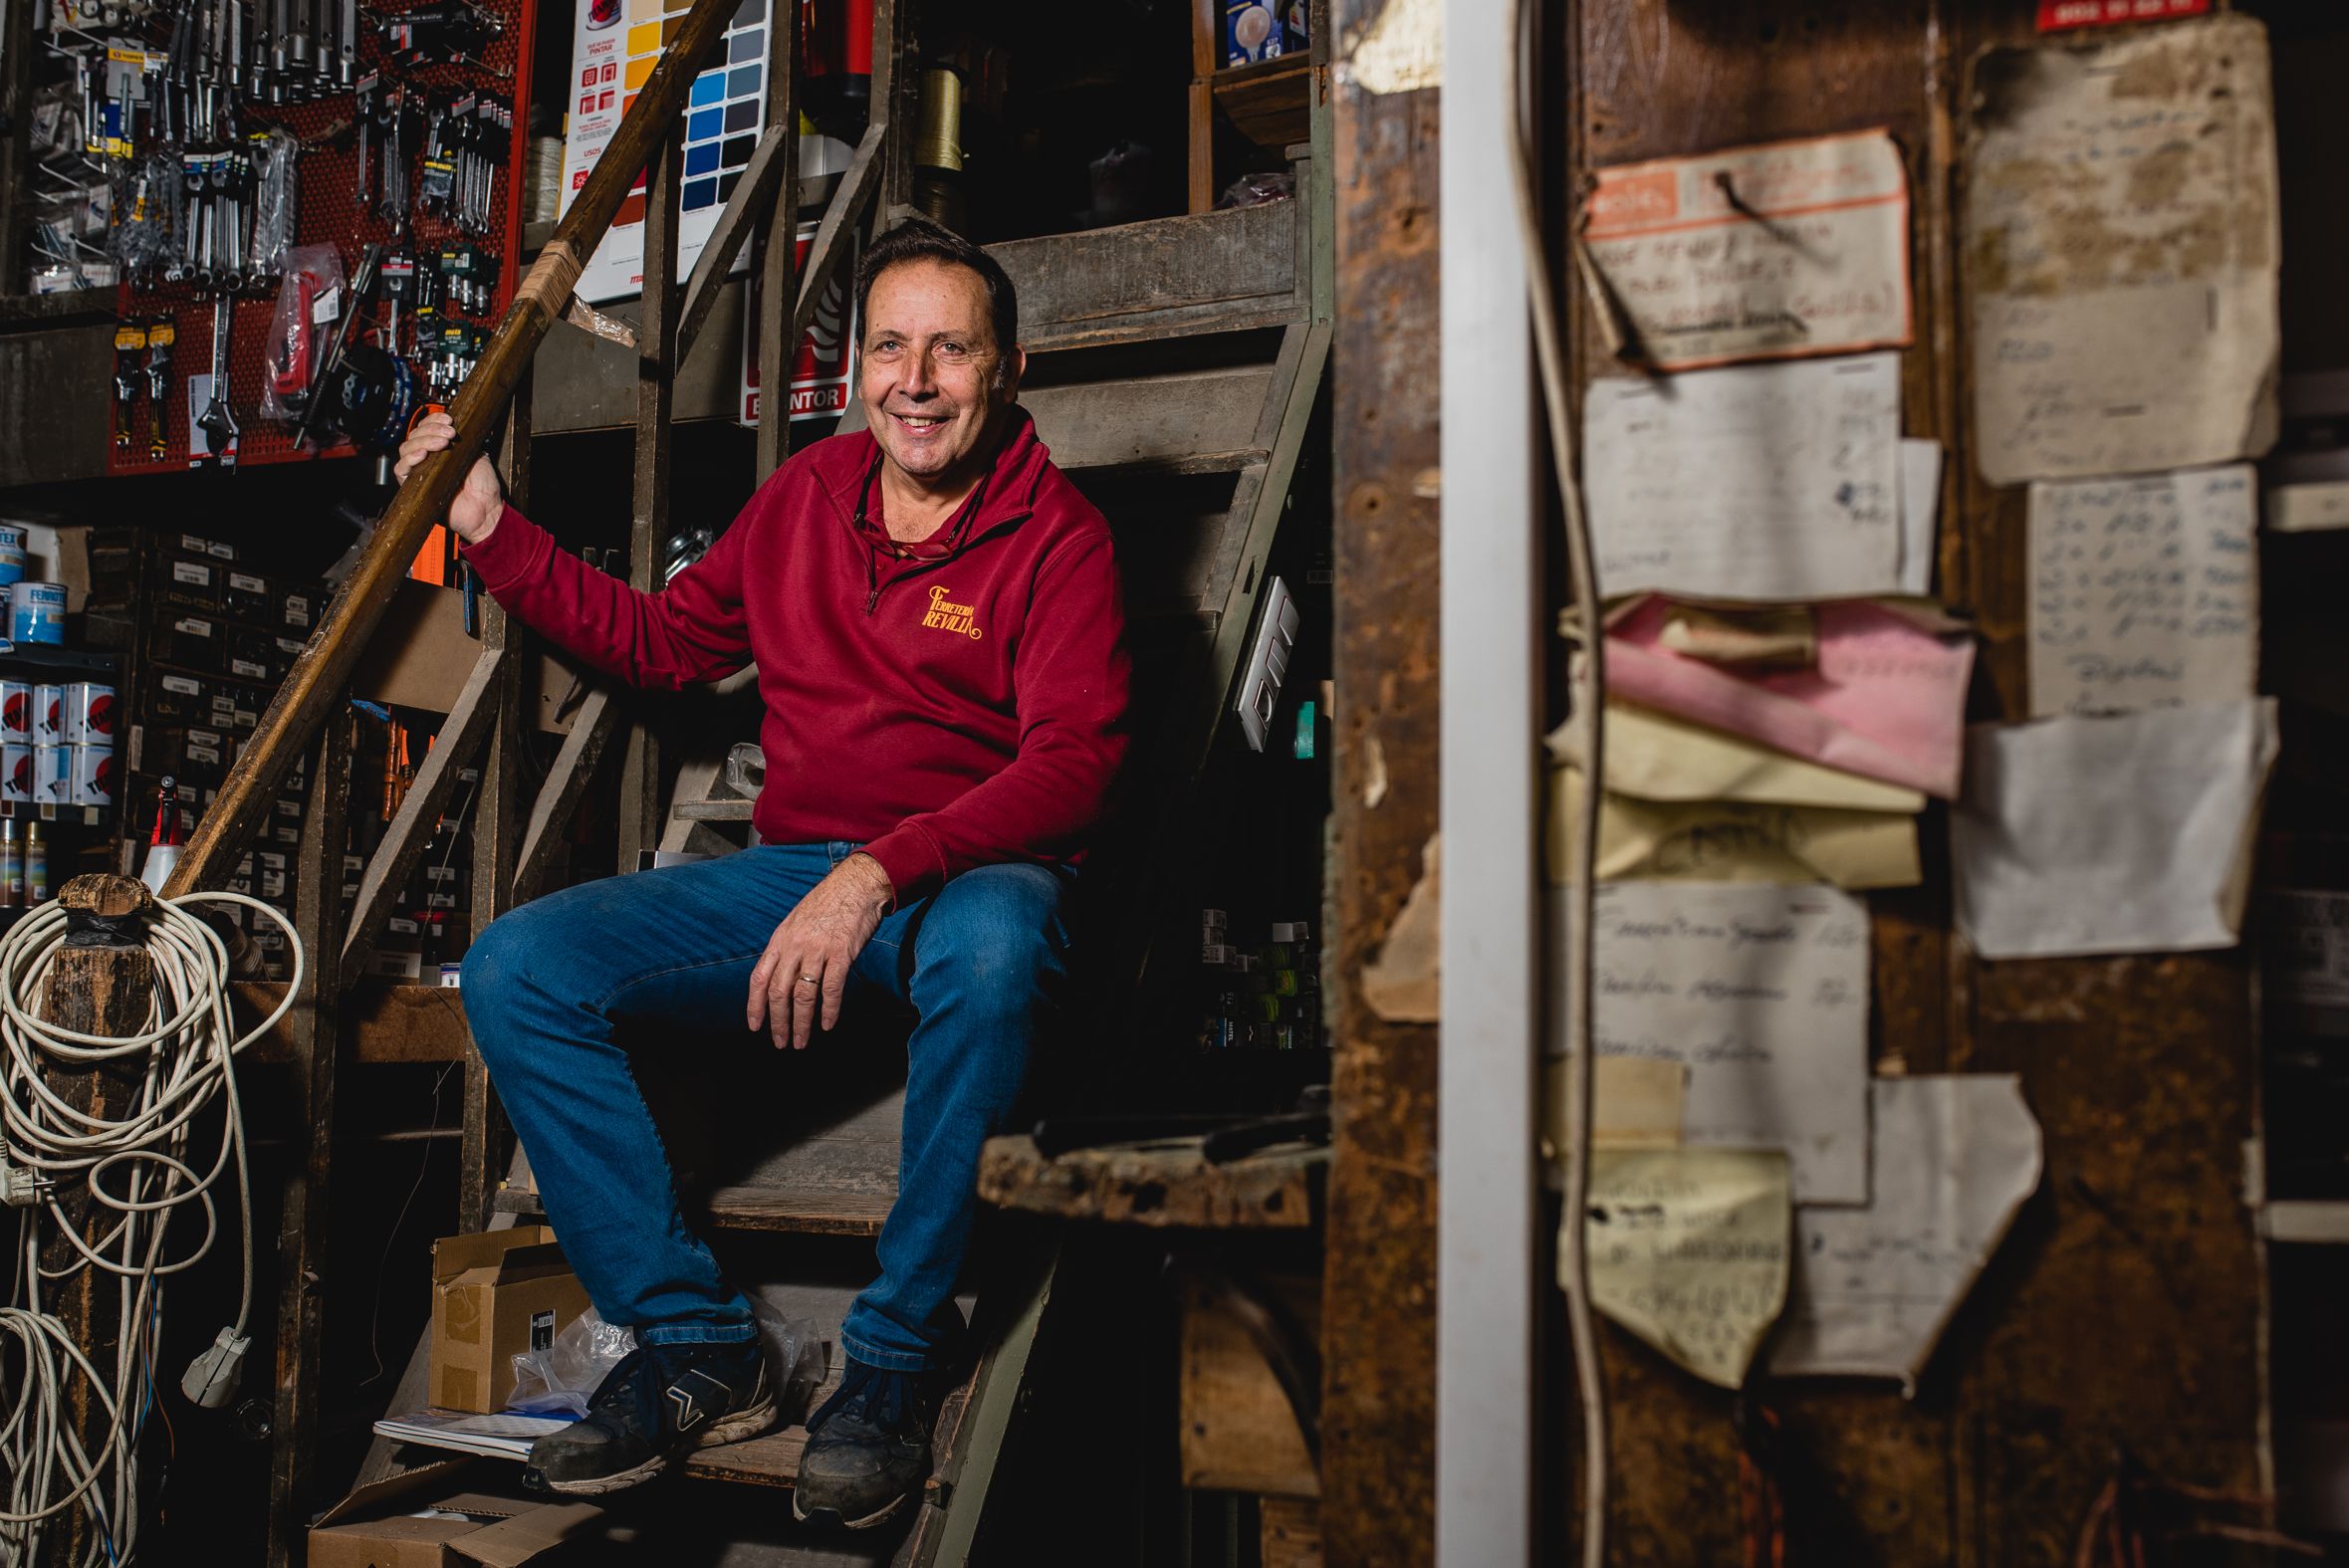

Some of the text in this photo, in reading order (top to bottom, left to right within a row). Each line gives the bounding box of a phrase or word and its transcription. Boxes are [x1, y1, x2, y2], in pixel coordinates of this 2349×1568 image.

[589, 45, 612, 55] PINTAR
[584, 147, 601, 157] USOS
[753, 389, 838, 415] ENTOR
[922, 610, 982, 639] REVILLA
